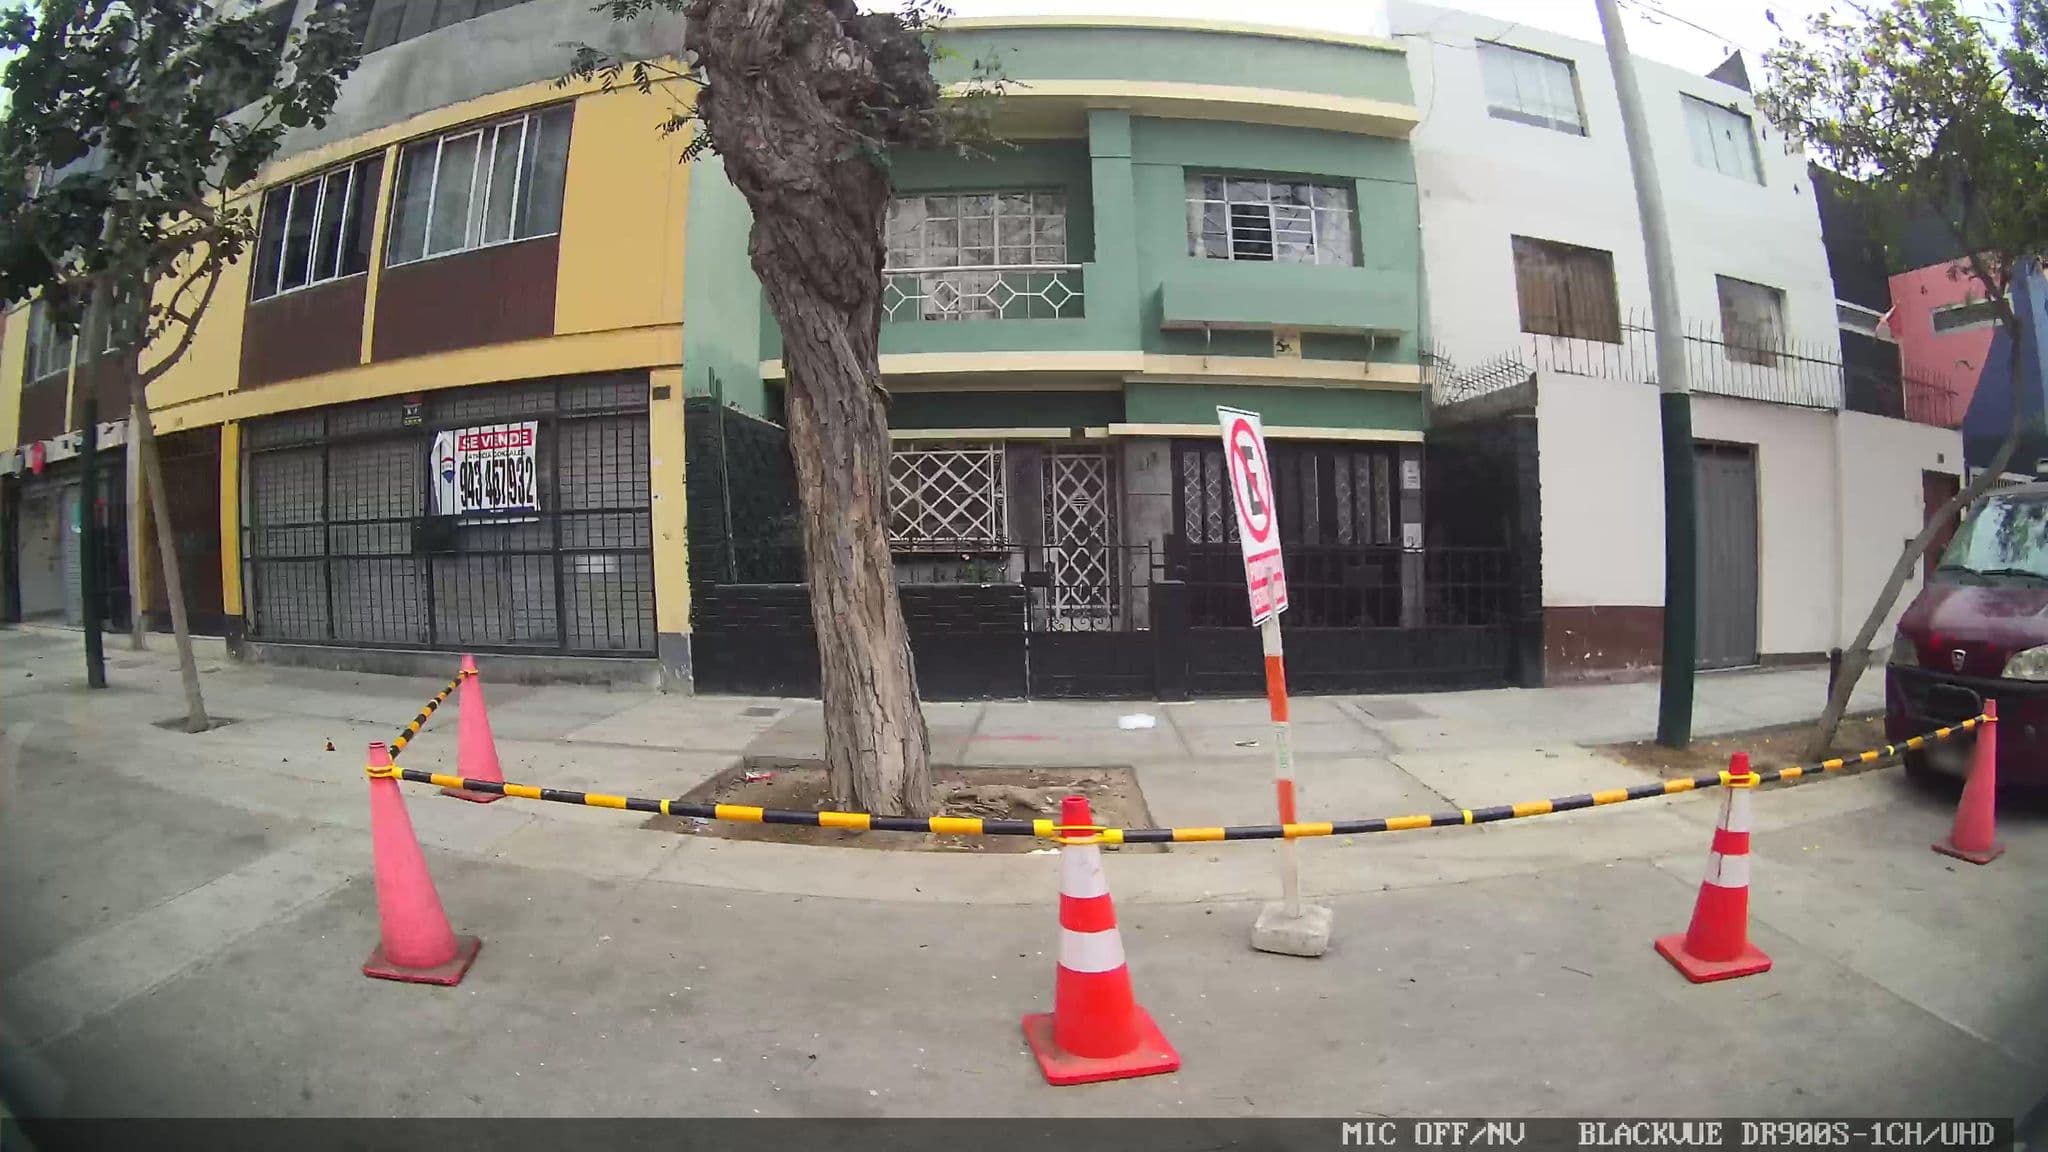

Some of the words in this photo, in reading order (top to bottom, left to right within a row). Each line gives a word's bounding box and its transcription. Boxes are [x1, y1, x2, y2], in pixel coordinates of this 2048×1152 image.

[462, 436, 479, 450] SE
[480, 431, 529, 448] VENDE
[460, 461, 482, 507] 943
[507, 456, 534, 505] 932
